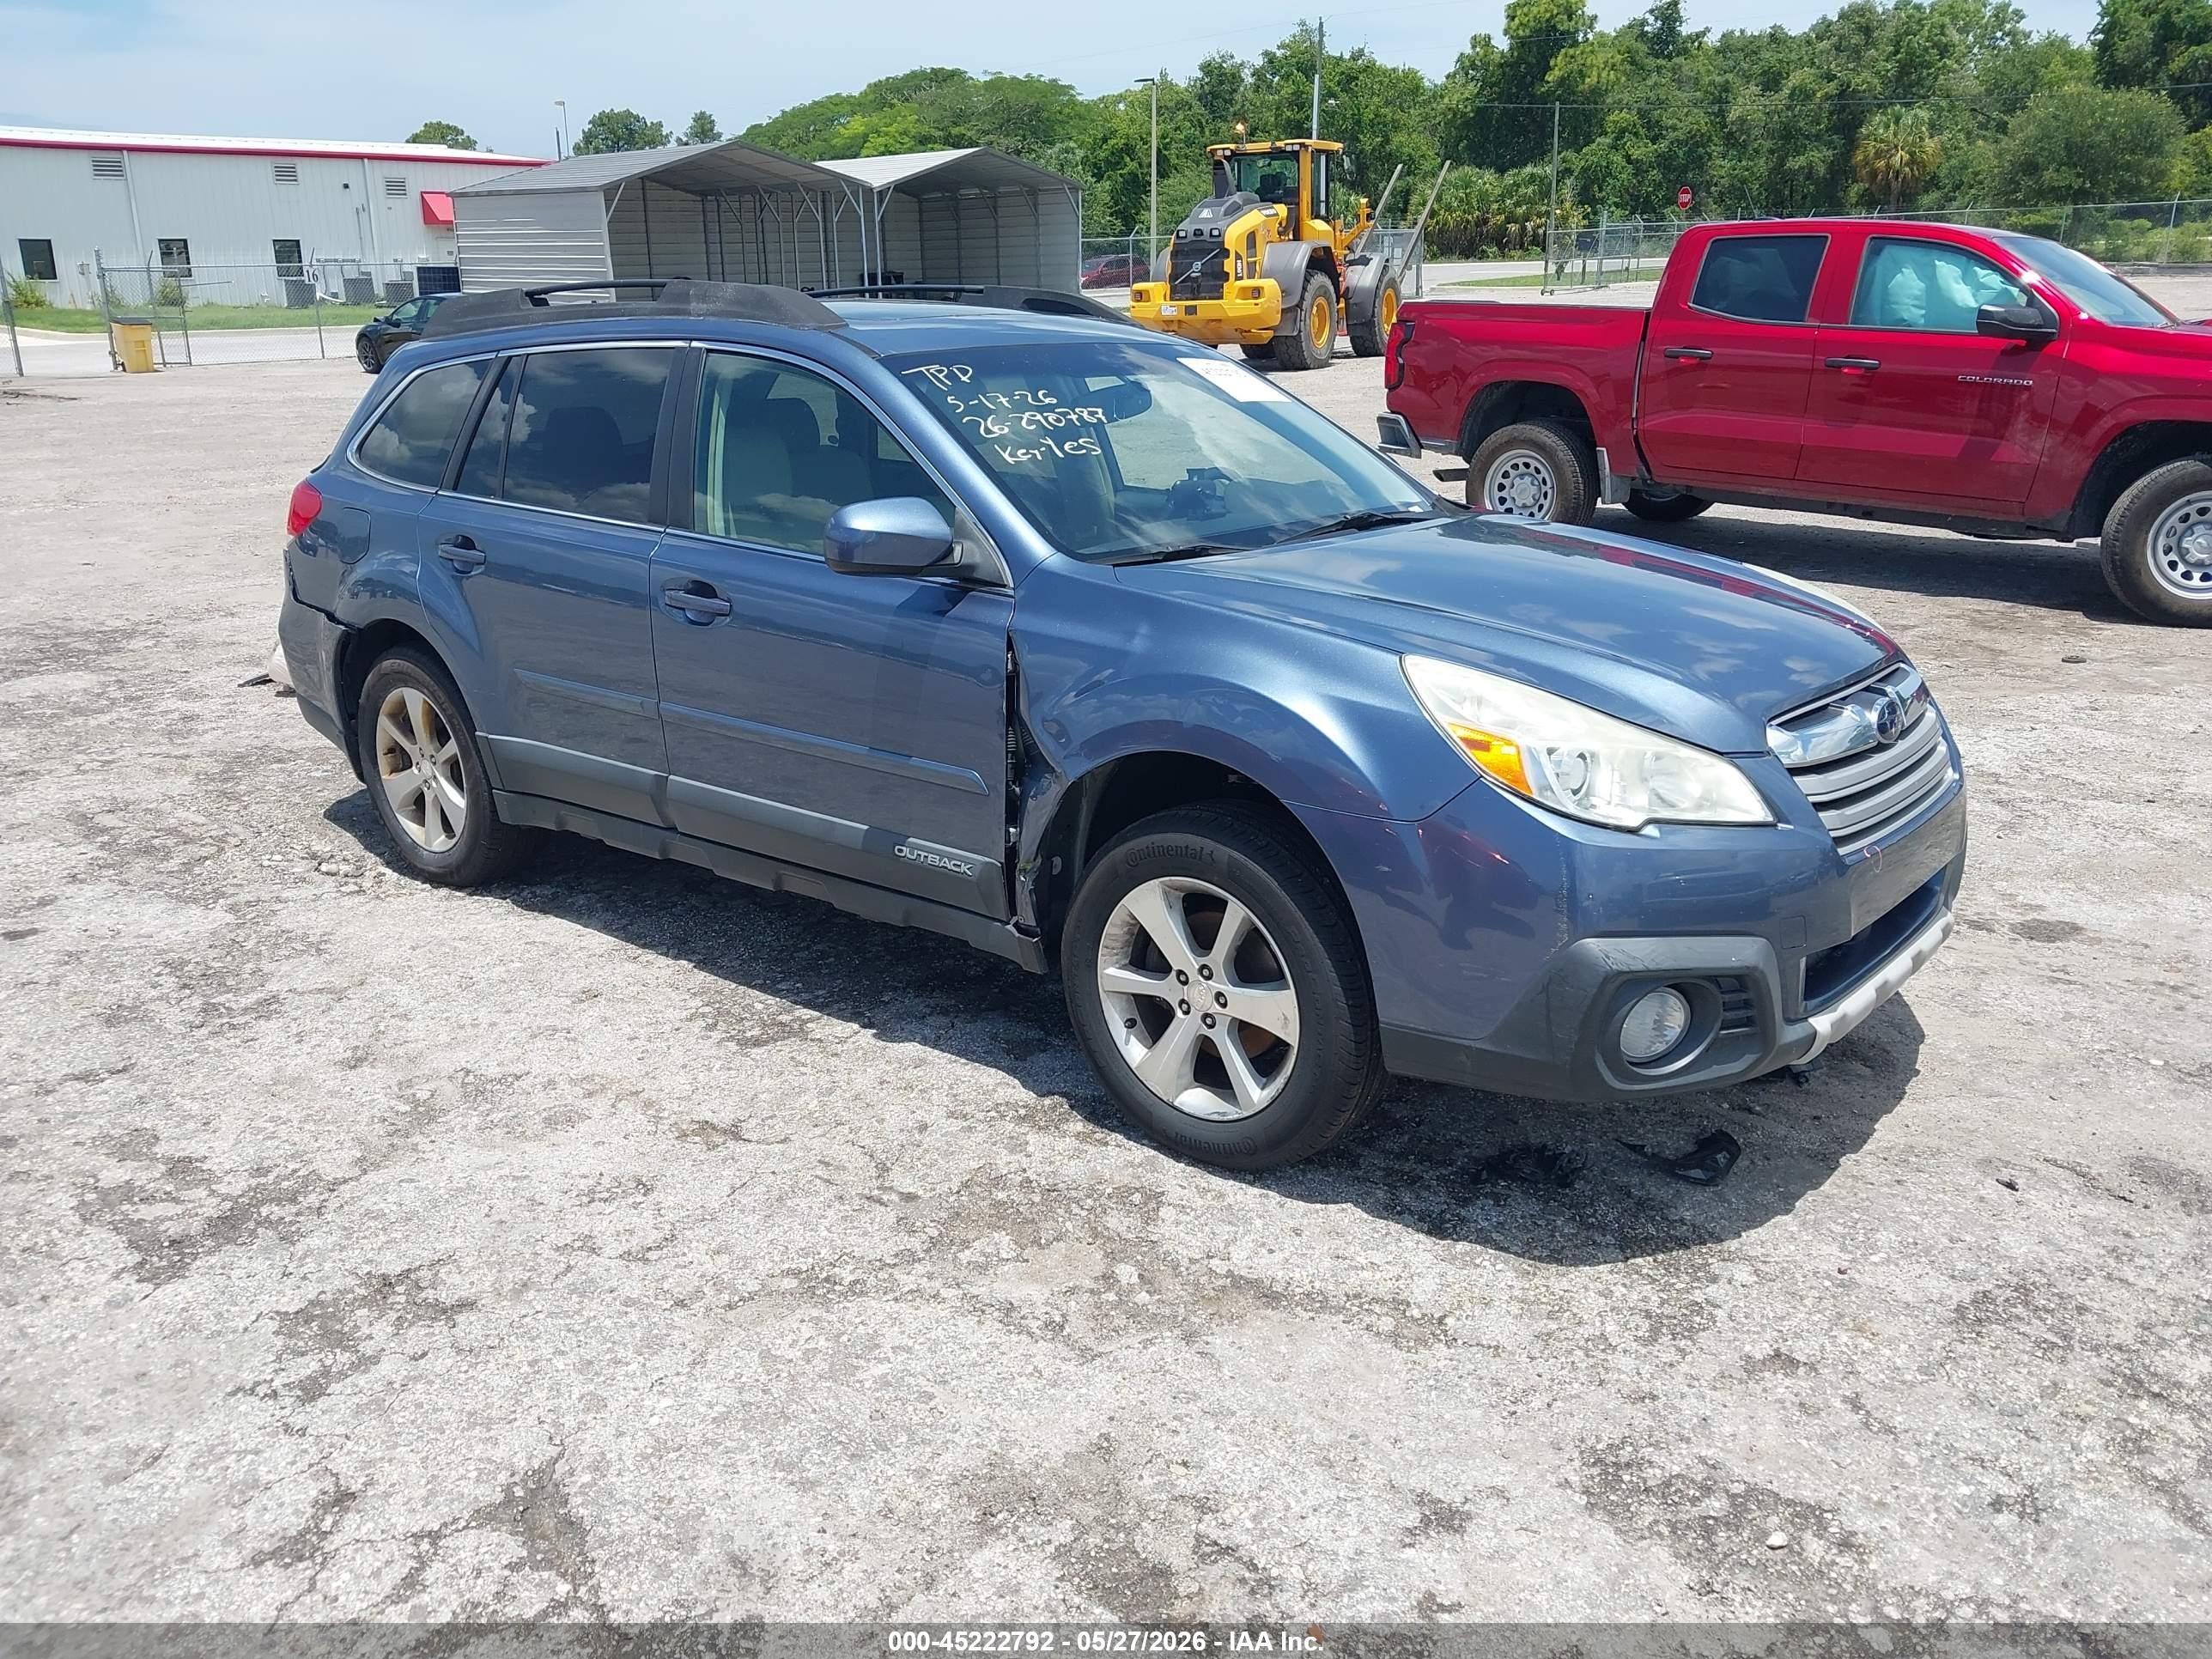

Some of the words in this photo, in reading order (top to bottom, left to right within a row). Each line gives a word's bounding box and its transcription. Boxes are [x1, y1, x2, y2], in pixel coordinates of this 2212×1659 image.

[1679, 193, 1691, 203] STOP
[306, 268, 319, 283] 16
[901, 365, 973, 392] TPD
[1957, 375, 2033, 386] COLORADO
[947, 390, 1058, 413] 5-17-26
[894, 845, 974, 876] OUTBACK
[1126, 842, 1205, 867] Continental
